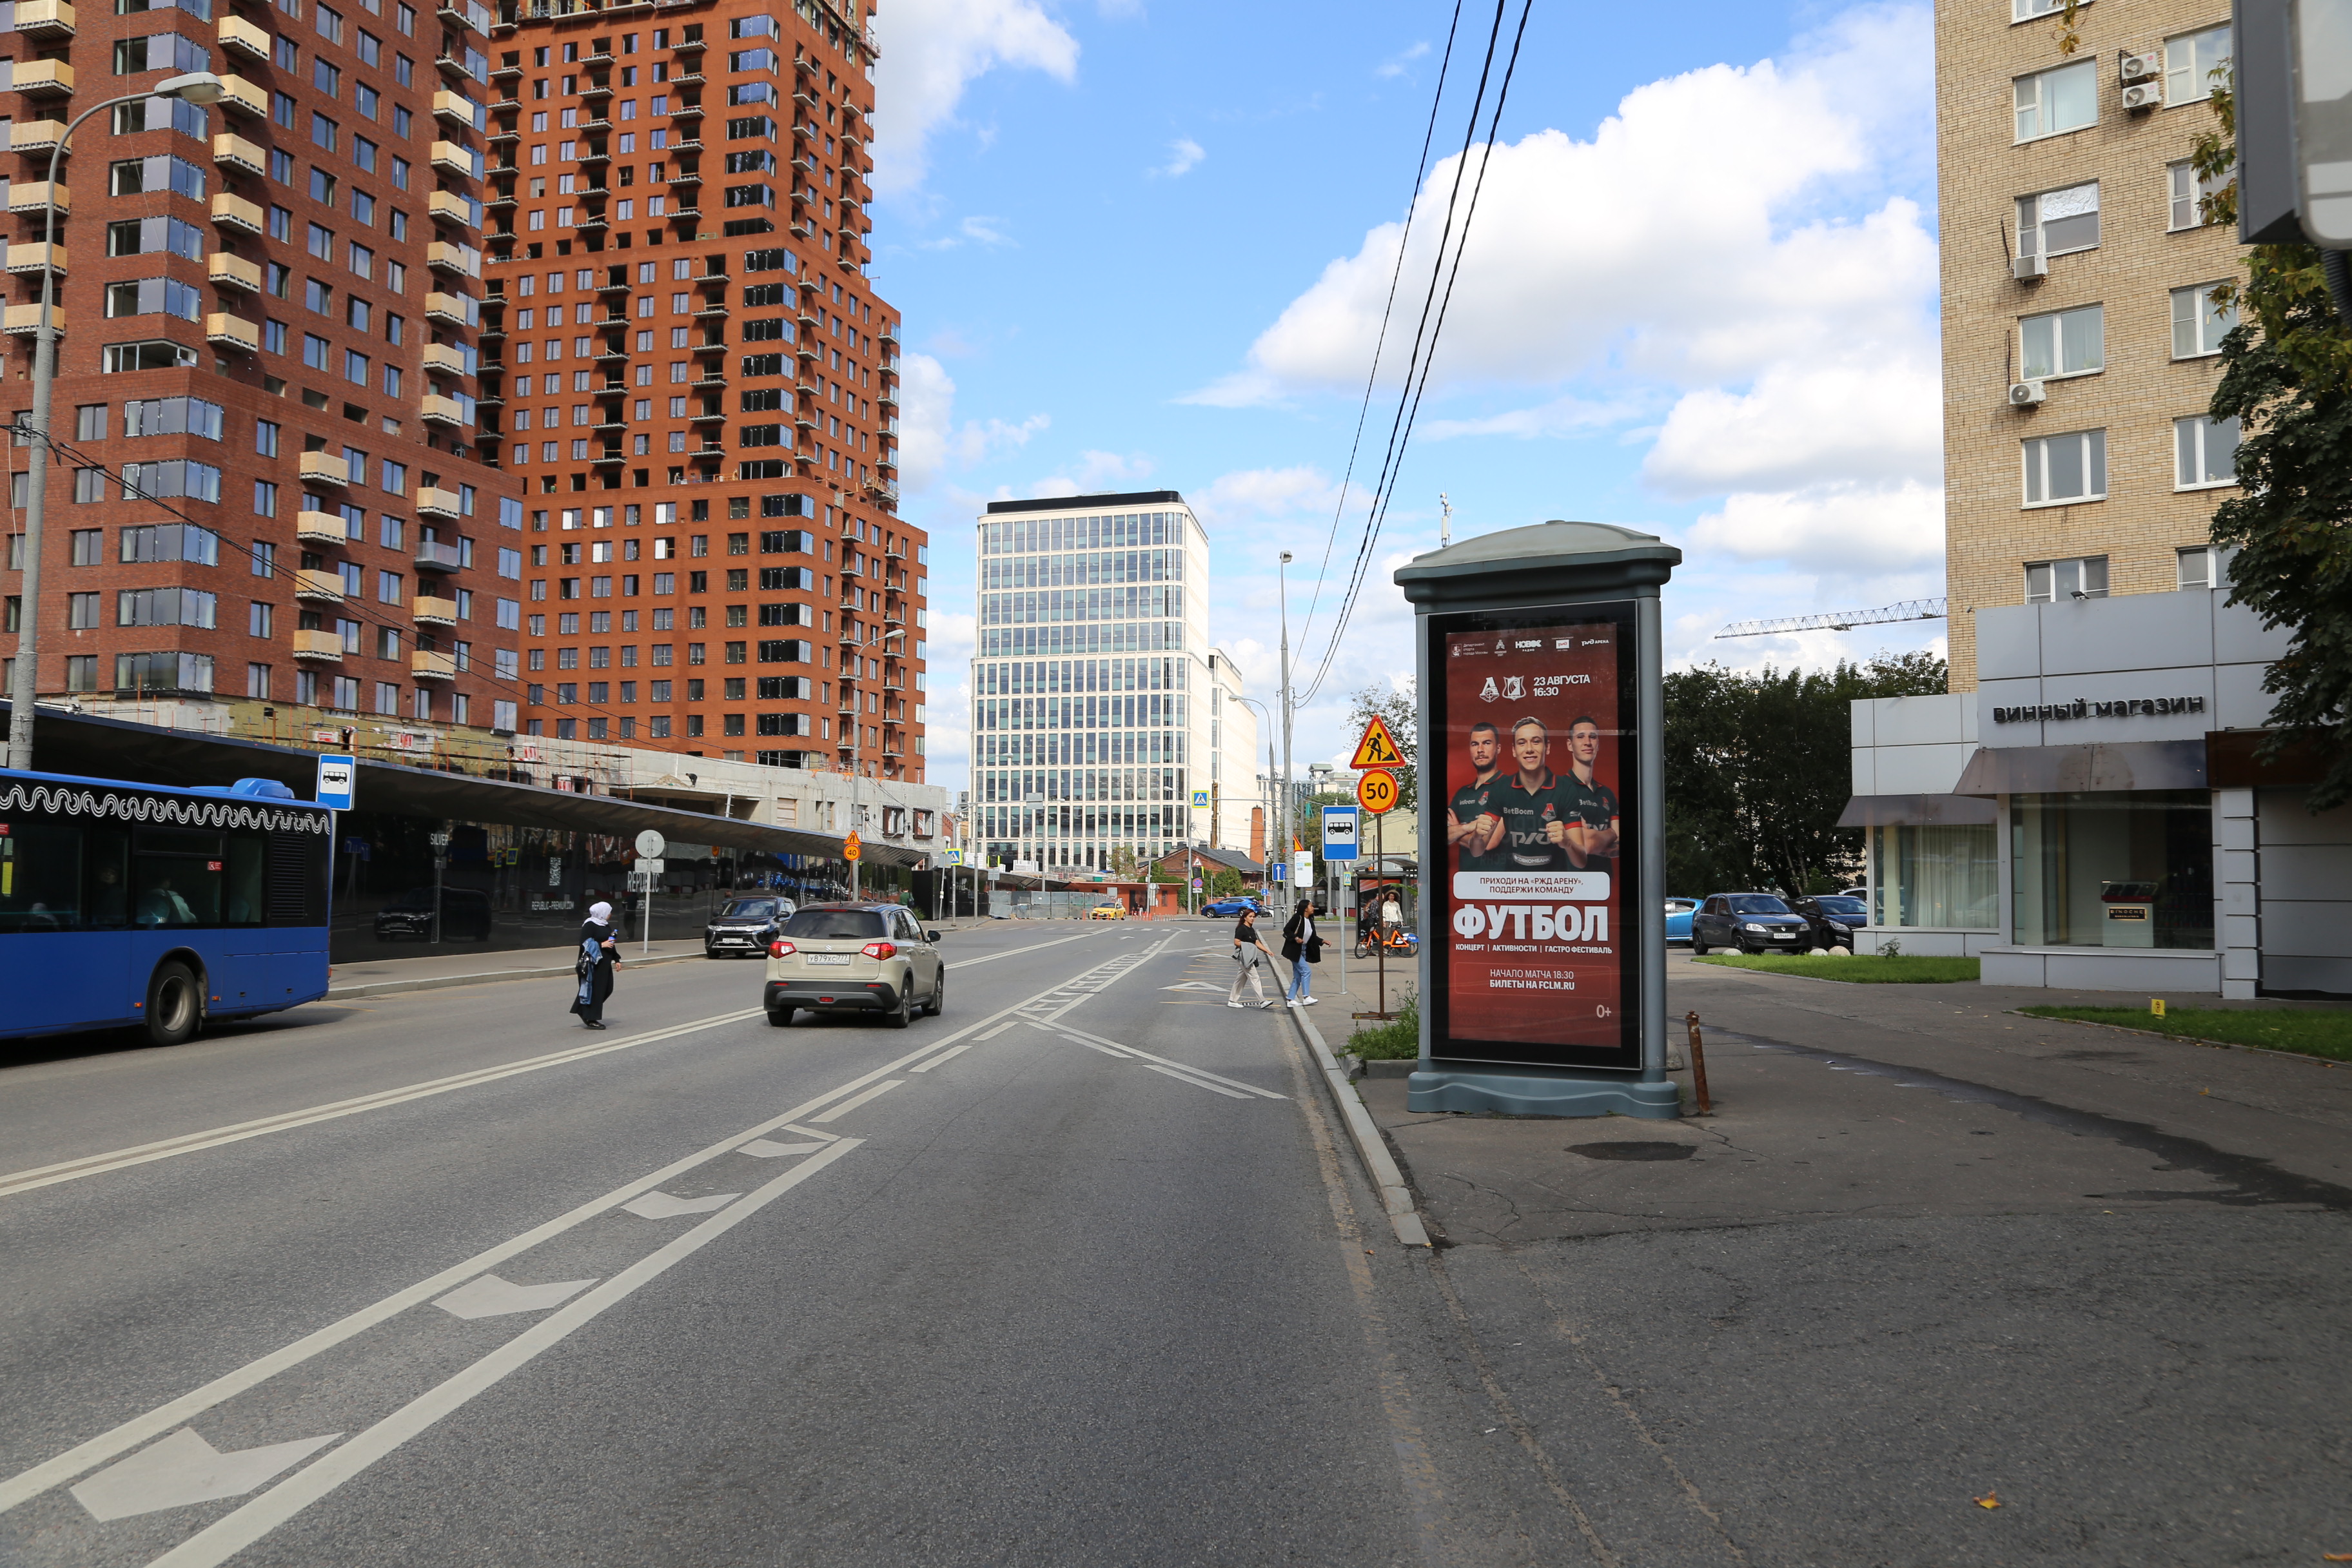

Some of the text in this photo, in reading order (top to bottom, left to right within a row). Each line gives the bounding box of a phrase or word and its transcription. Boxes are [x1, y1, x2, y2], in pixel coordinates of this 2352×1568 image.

[1533, 674, 1591, 687] 23 АВГУСТА
[1533, 687, 1559, 697] 16:30
[1366, 782, 1389, 800] 50
[430, 833, 449, 846] SILVER
[1489, 886, 1533, 894] ПОДДЕРЖИ
[1453, 903, 1609, 941] ФУТБОЛ
[1490, 969, 1574, 979] НАЧАЛО МАТЧА 18:30
[1489, 979, 1574, 990] БИЛЕТЫ НА FCLM.RU
[1596, 1004, 1611, 1018] 0+
